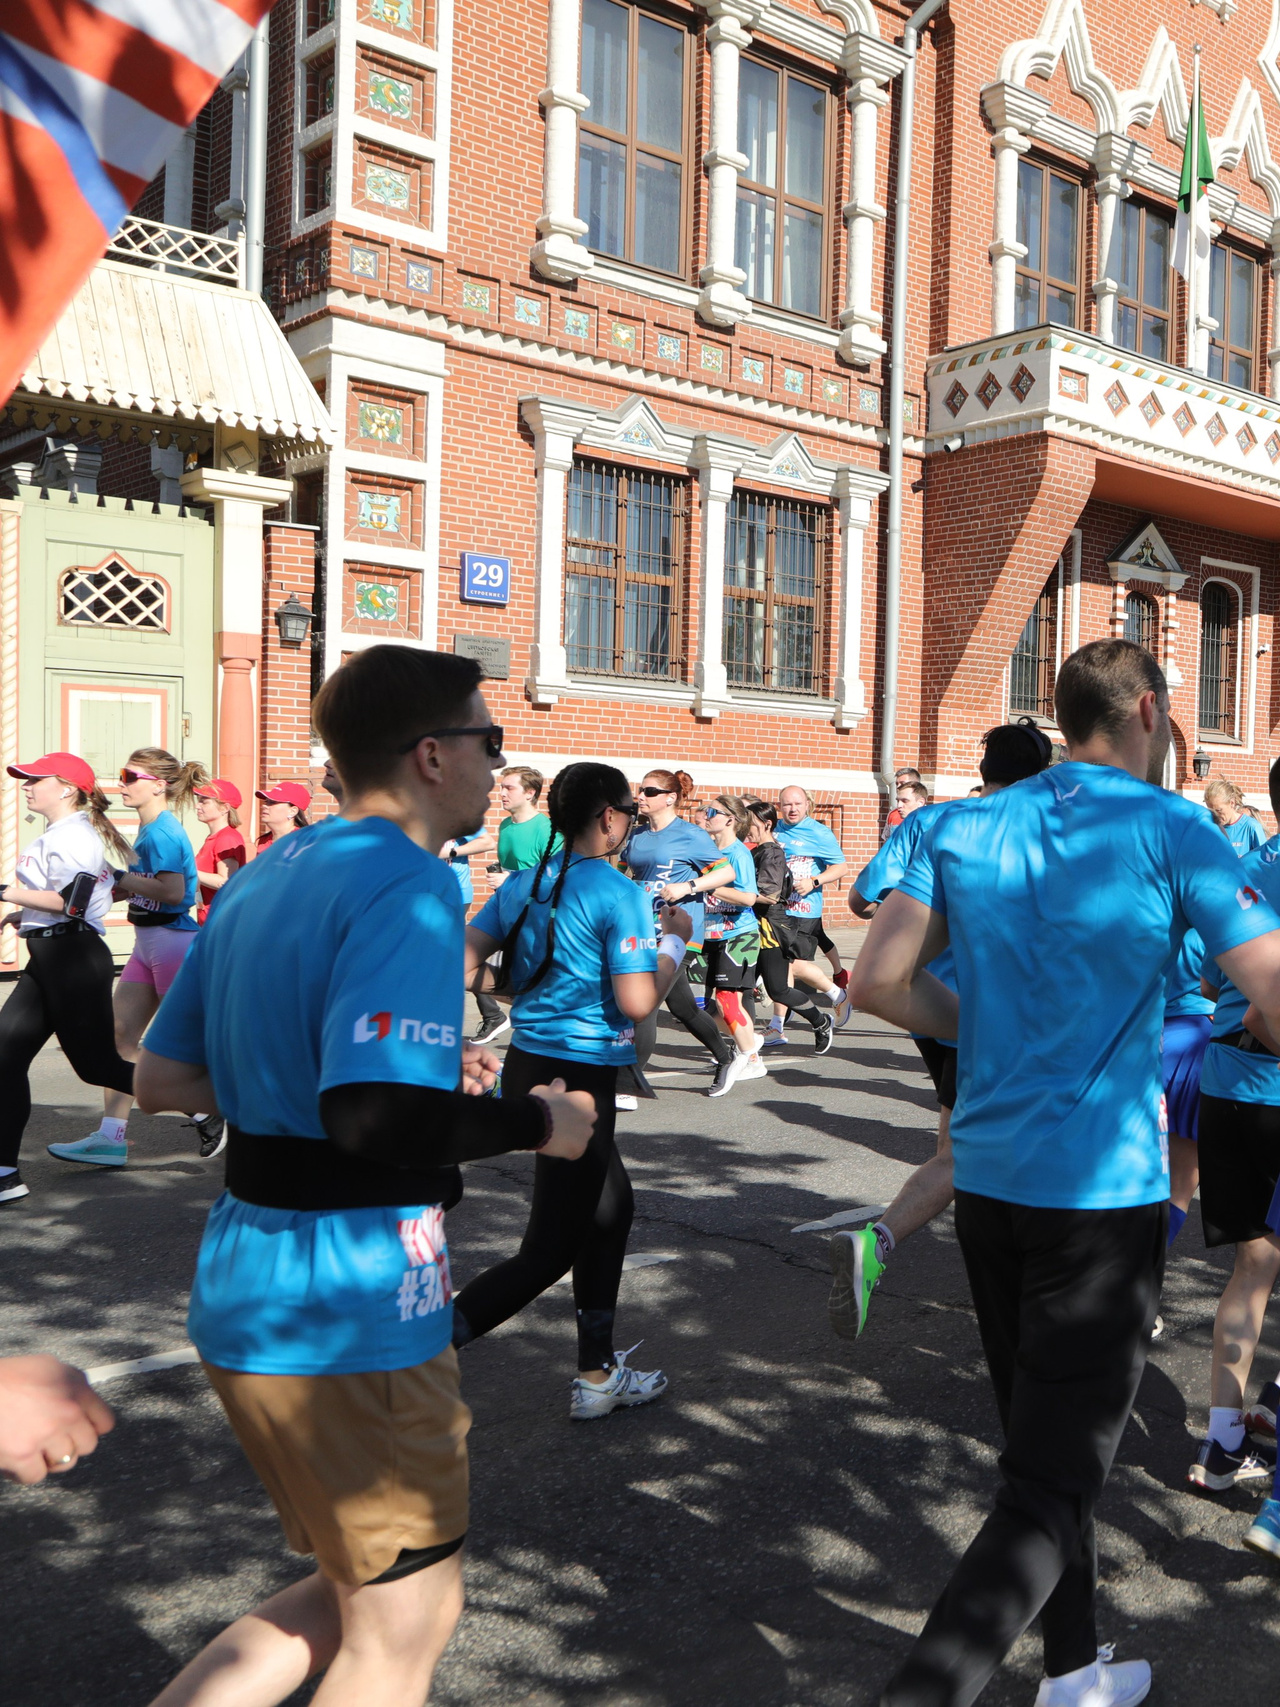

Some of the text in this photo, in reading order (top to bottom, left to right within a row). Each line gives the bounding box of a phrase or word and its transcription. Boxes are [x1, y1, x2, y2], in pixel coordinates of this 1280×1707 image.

[472, 562, 504, 588] 29
[470, 589, 501, 598] СТРОЕНИЕ
[639, 938, 657, 950] ПС
[399, 1018, 456, 1048] ПСБ
